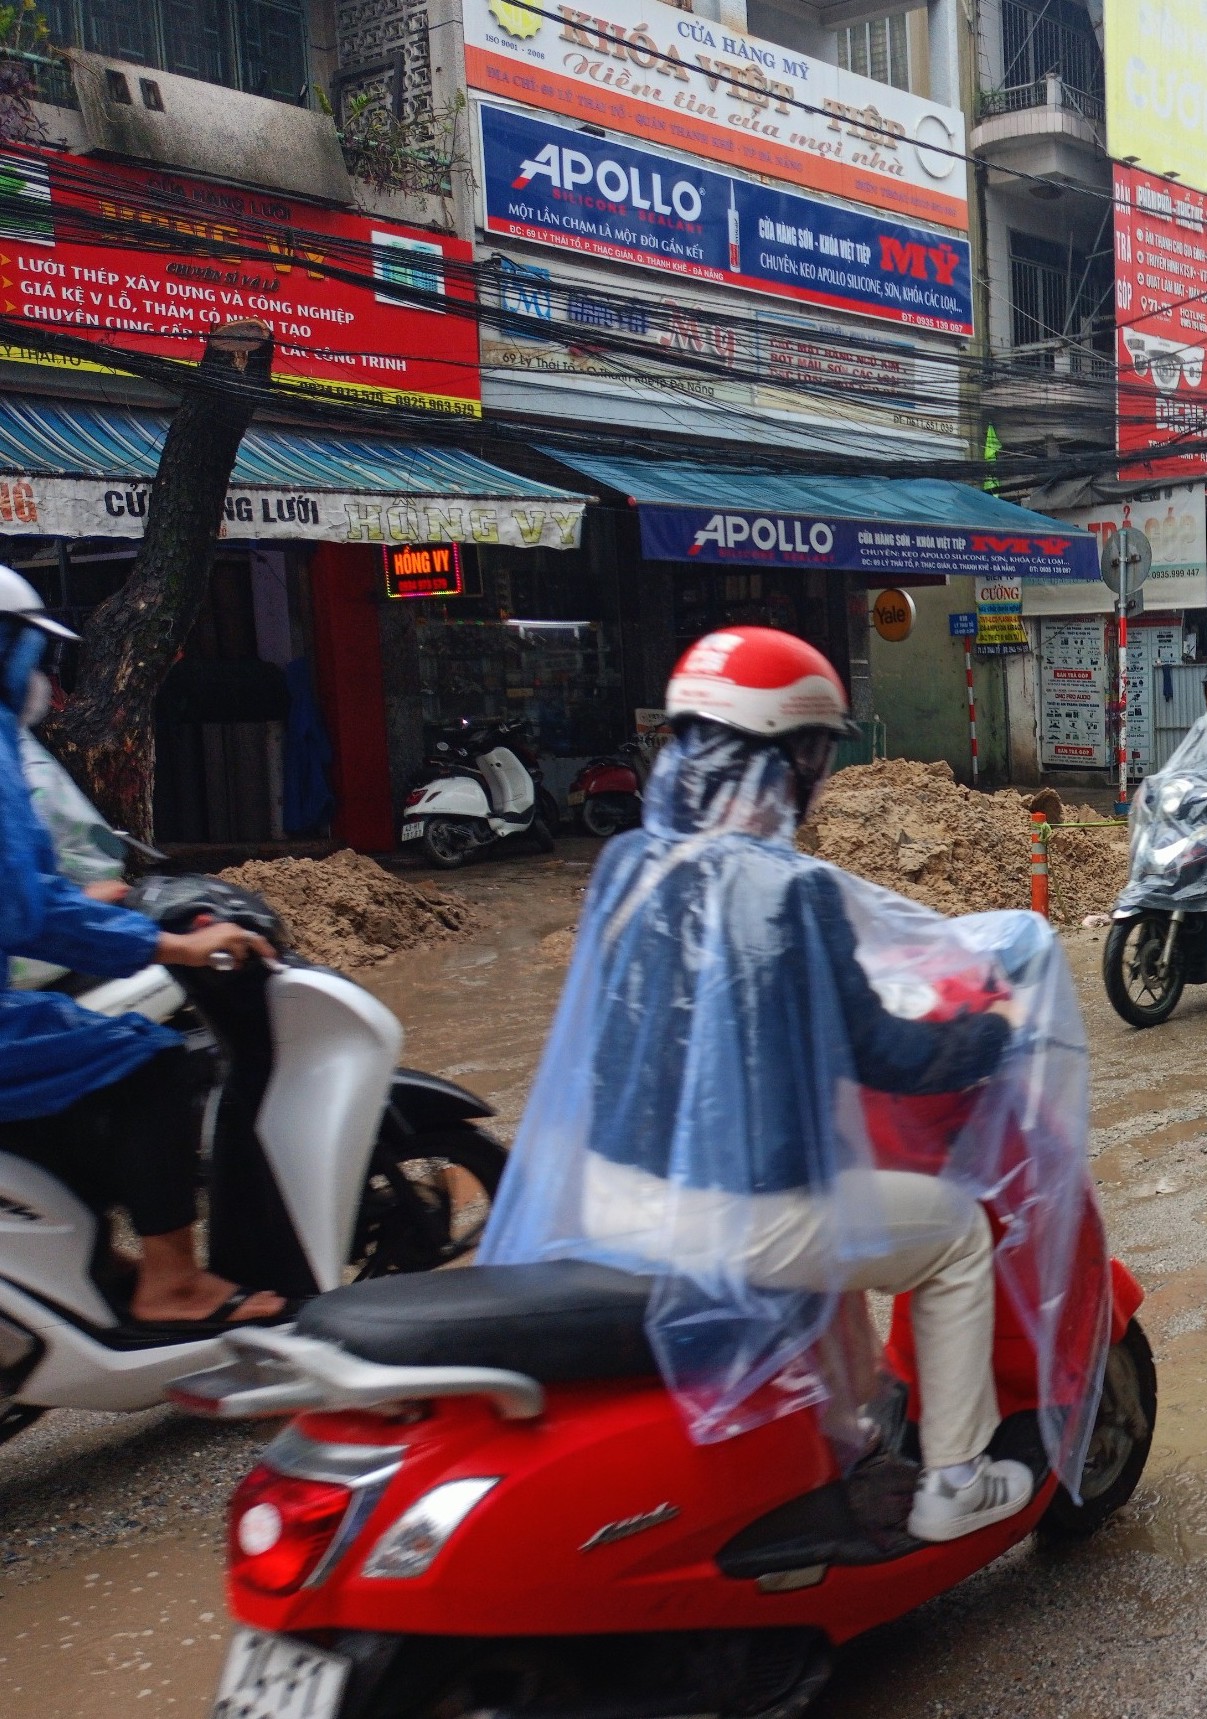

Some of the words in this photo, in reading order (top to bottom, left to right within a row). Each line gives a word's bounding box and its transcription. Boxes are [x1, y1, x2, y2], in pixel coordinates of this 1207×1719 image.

[485, 33, 499, 47] ISO
[501, 39, 518, 52] 9001
[558, 4, 690, 83] KHÓA
[722, 35, 776, 70] HÀNG
[782, 57, 810, 81] MỸ
[673, 91, 720, 120] tin
[728, 107, 781, 139] của
[790, 131, 845, 159] mọi
[851, 148, 905, 177] nhà
[511, 144, 703, 222] APOLLO
[551, 186, 628, 216] SILICONE
[1115, 180, 1131, 216] BÁN
[508, 203, 534, 222] MỘT
[537, 205, 561, 225] LẦN
[562, 216, 597, 236] CHẠM
[599, 222, 612, 238] LÀ
[614, 228, 638, 247] MỘT
[661, 238, 685, 256] GẮN
[686, 244, 705, 261] KẾT
[776, 221, 798, 246] HÀNG
[1116, 226, 1132, 263] TRẢ
[526, 228, 537, 239] 69
[537, 229, 549, 241] LÝ
[593, 243, 615, 258] THẠC
[647, 256, 672, 270] THANH
[672, 259, 689, 274] KHÊ
[879, 235, 960, 287] MỸ
[18, 256, 66, 278] LƯỚI
[71, 266, 120, 287] THÉP
[125, 274, 161, 293] XÂY
[166, 282, 216, 303] DỰNG
[220, 290, 244, 307] VÀ
[247, 295, 293, 315] CÔNG
[297, 304, 355, 325] NGHIỆP
[760, 252, 800, 275] CHUYÊN:
[799, 262, 816, 280] KEO
[817, 266, 847, 288] APOLLO
[847, 274, 884, 298] SILICONE,
[902, 284, 924, 306] KHÓA
[924, 289, 940, 309] CÁC
[1117, 275, 1133, 310] GÓP
[20, 280, 56, 298] GIÁ
[61, 286, 85, 305] KỆ
[90, 292, 103, 306] V
[108, 291, 138, 314] LỖ,
[142, 300, 194, 321] THẢM
[199, 307, 221, 324] CỎ
[278, 321, 312, 339] TẠO
[901, 312, 916, 325] ĐT:
[916, 316, 935, 329] 0935
[936, 320, 950, 332] 139
[950, 322, 964, 334] 097
[1180, 308, 1206, 323] HOTLINE
[503, 352, 517, 364] 69
[104, 482, 151, 518] CỬ
[260, 492, 320, 525] LƯỚI
[511, 509, 582, 545] VY
[688, 514, 834, 556] APOLLO
[874, 531, 895, 547] HÀNG
[393, 545, 432, 576] HỒNG
[433, 550, 450, 573] VY
[901, 551, 919, 559] KEO
[920, 551, 951, 561] APOLLO
[951, 554, 988, 563] SILICONE,
[1009, 555, 1031, 565] KHÓA
[1031, 556, 1047, 565] CÁC
[980, 584, 1020, 601] CƯỜNG
[876, 606, 907, 627] Yale
